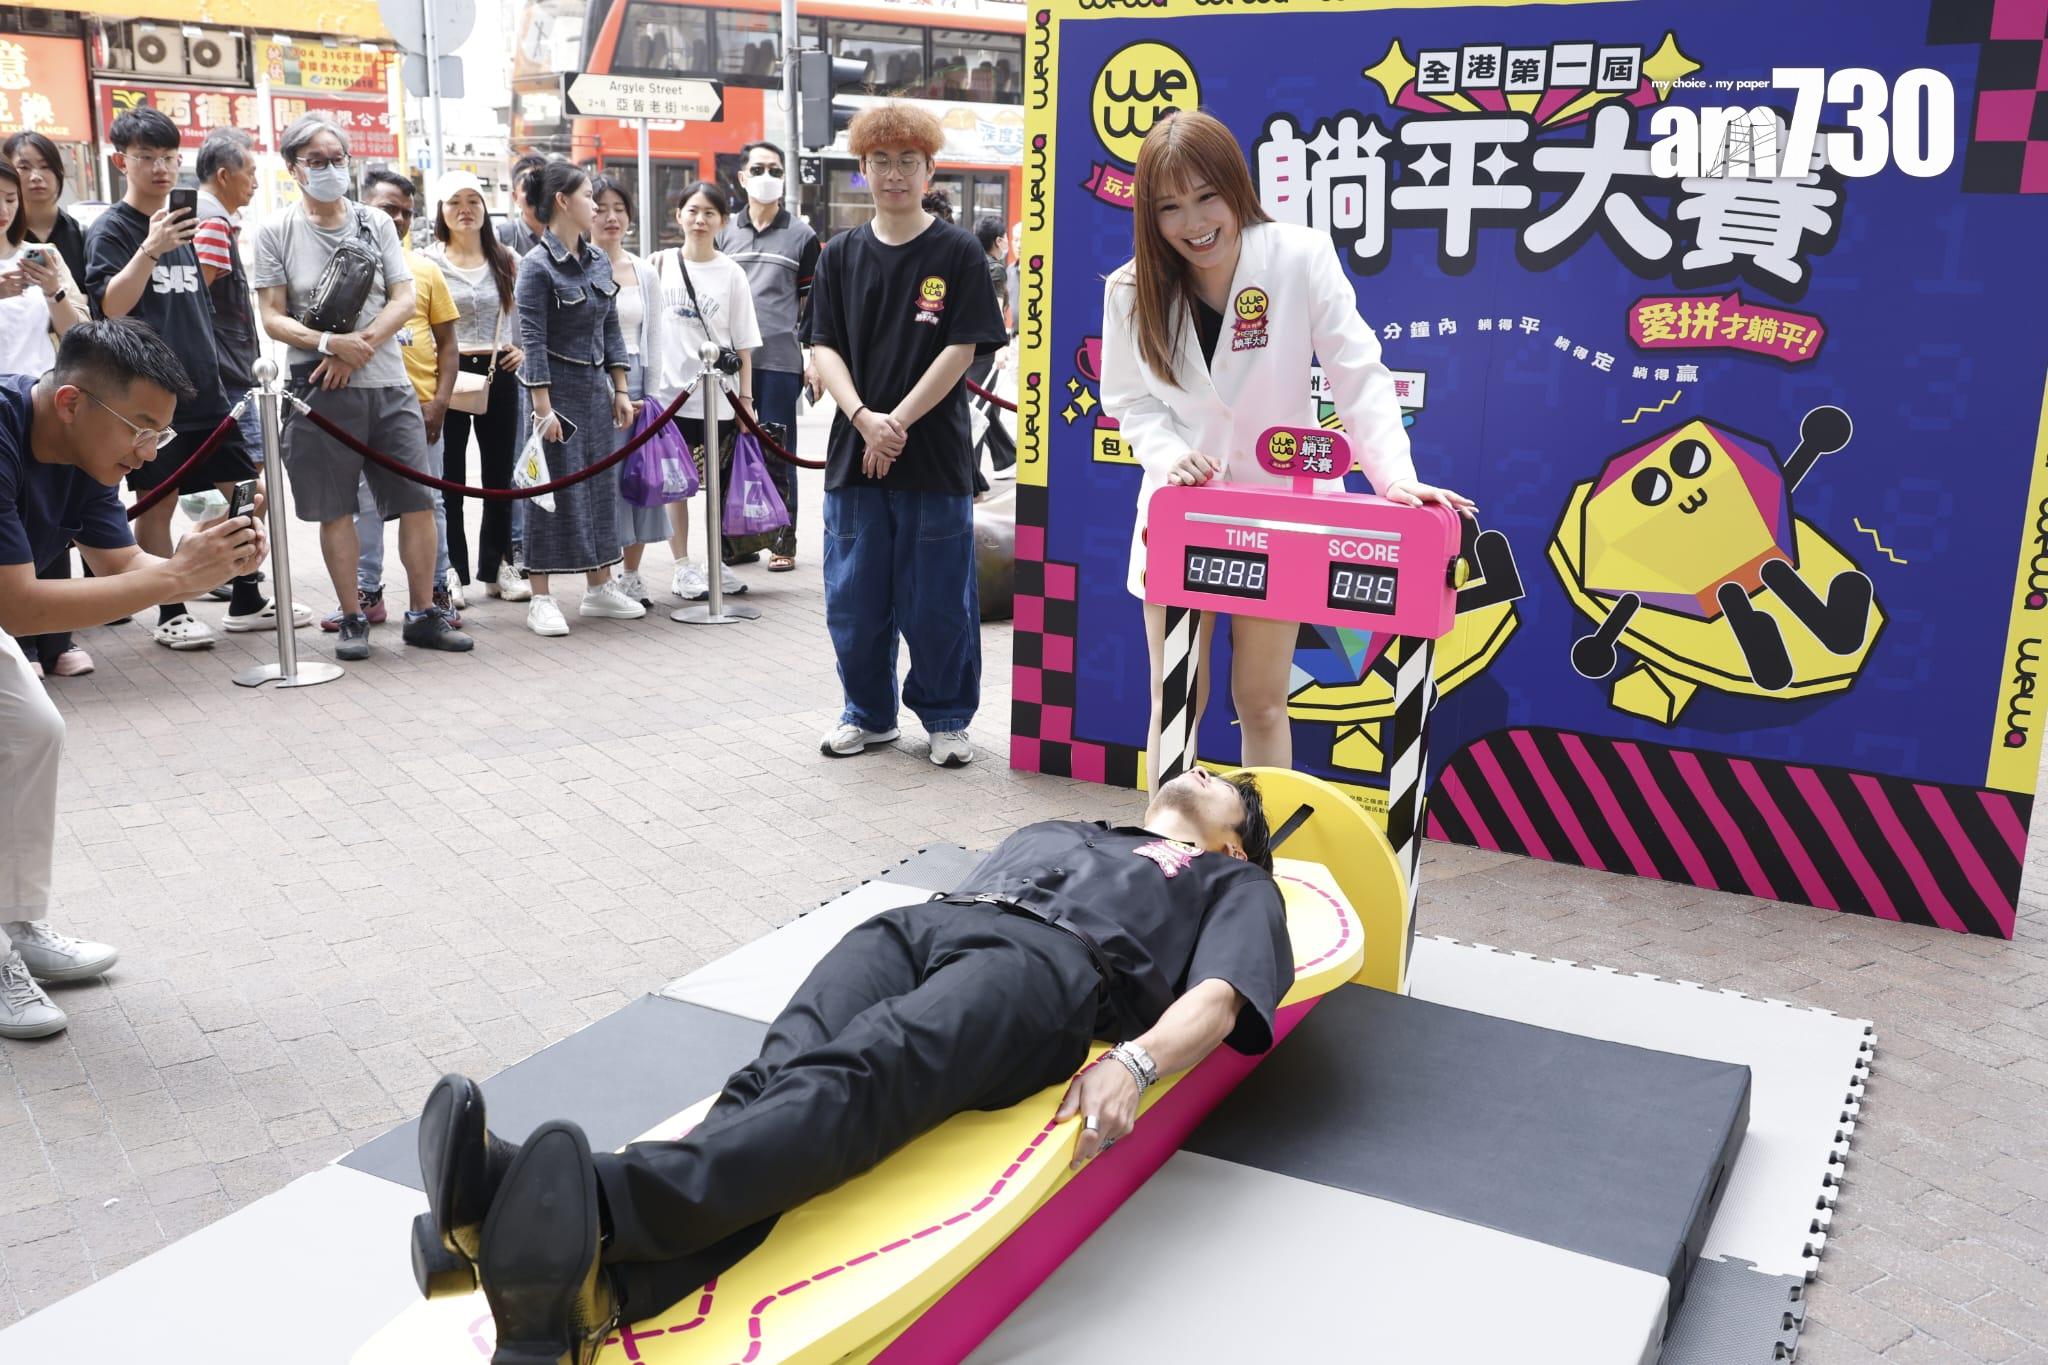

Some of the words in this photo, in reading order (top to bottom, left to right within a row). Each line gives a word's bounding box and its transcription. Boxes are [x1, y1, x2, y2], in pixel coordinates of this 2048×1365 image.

[1032, 8, 1051, 110] wewa
[1422, 52, 1634, 87] 全港第一屆
[609, 81, 645, 95] Argyle
[649, 83, 683, 95] Street
[1105, 69, 1188, 102] we
[616, 98, 677, 113] 亞皆老街
[1029, 133, 1048, 232] wewa
[1027, 254, 1045, 350] wewa
[1372, 318, 1457, 340] 分鐘內
[1477, 316, 1541, 336] 躺得平
[1553, 336, 1616, 372] 躺得定
[1638, 301, 1818, 354] 愛拼才躺平!
[1024, 372, 1041, 464] wewa
[1225, 529, 1269, 549] TIME
[1328, 539, 1400, 563] SCORE
[1188, 556, 1265, 589] 4388
[1332, 571, 1395, 604] 045
[2003, 638, 2042, 748] wewa
